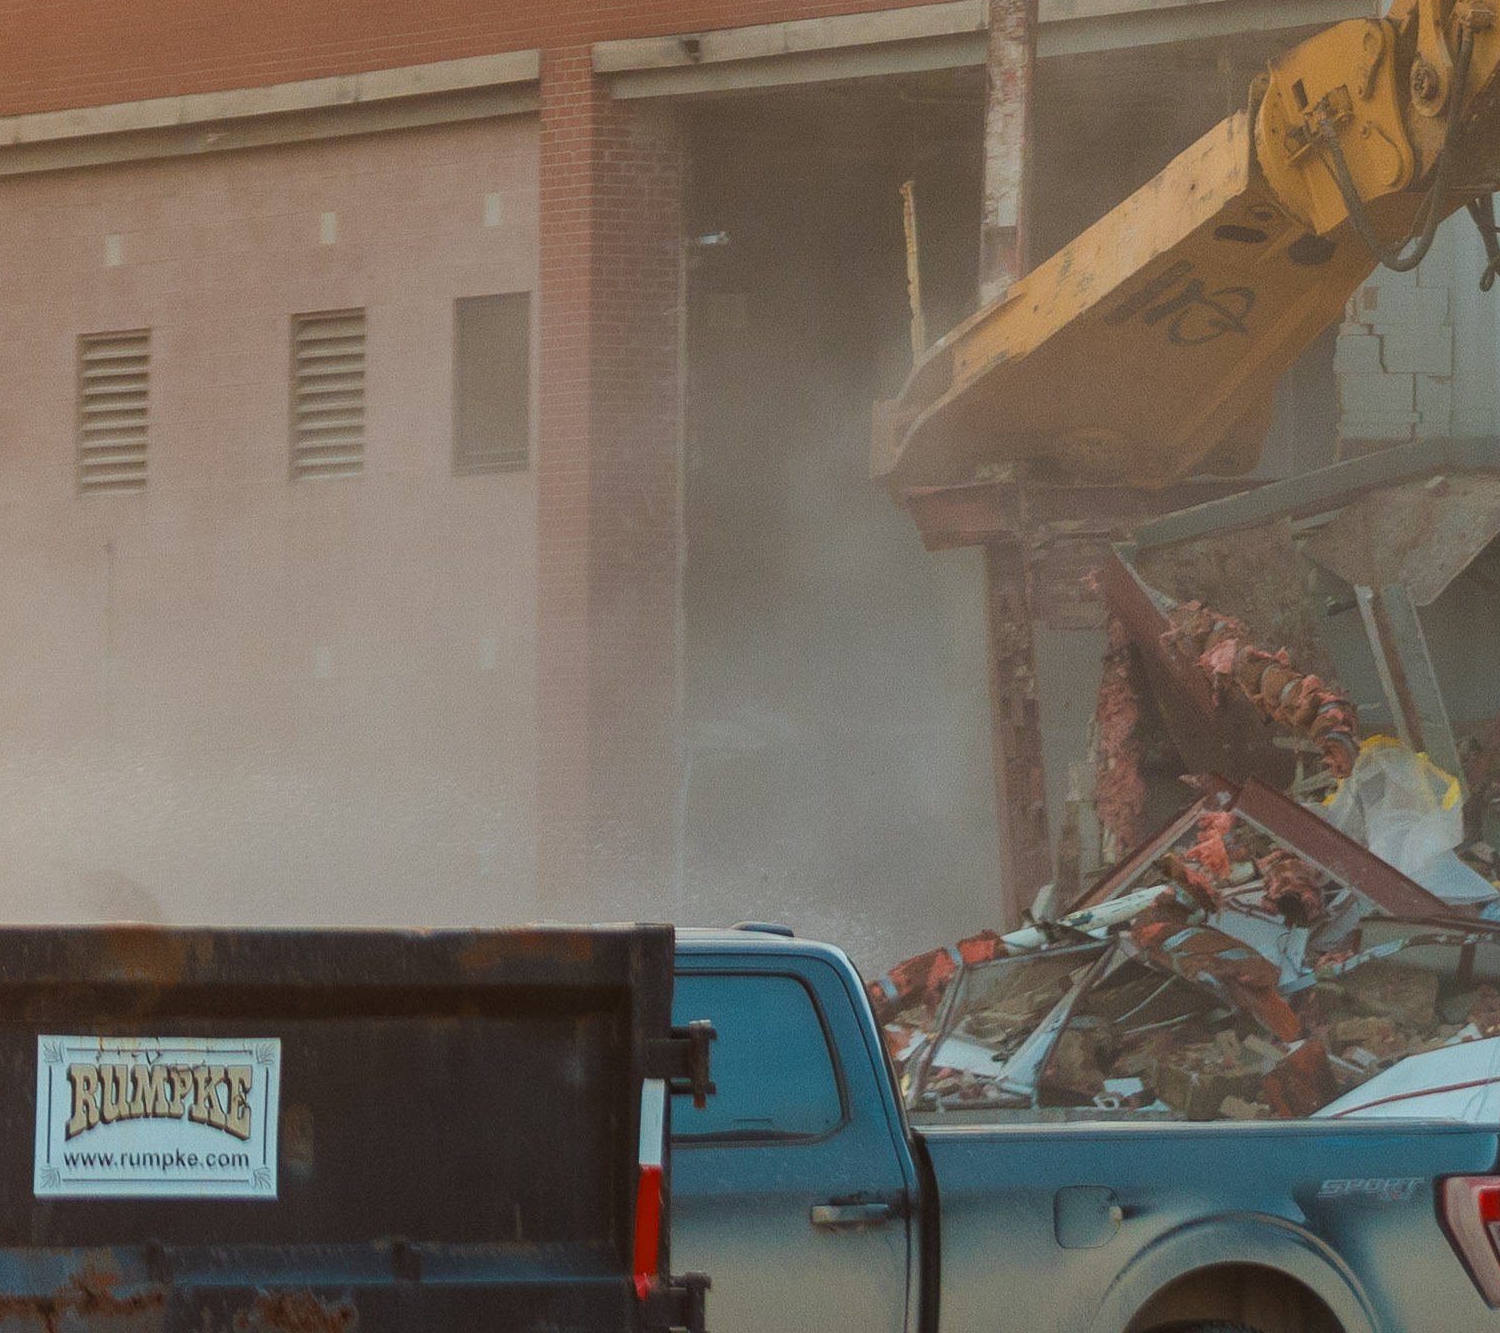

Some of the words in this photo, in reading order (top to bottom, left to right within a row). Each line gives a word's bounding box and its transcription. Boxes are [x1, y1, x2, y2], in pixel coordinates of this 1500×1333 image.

[65, 1064, 252, 1141] RUMPKE
[64, 1149, 249, 1170] www.rumpke.com
[1318, 1177, 1425, 1197] SPORT
